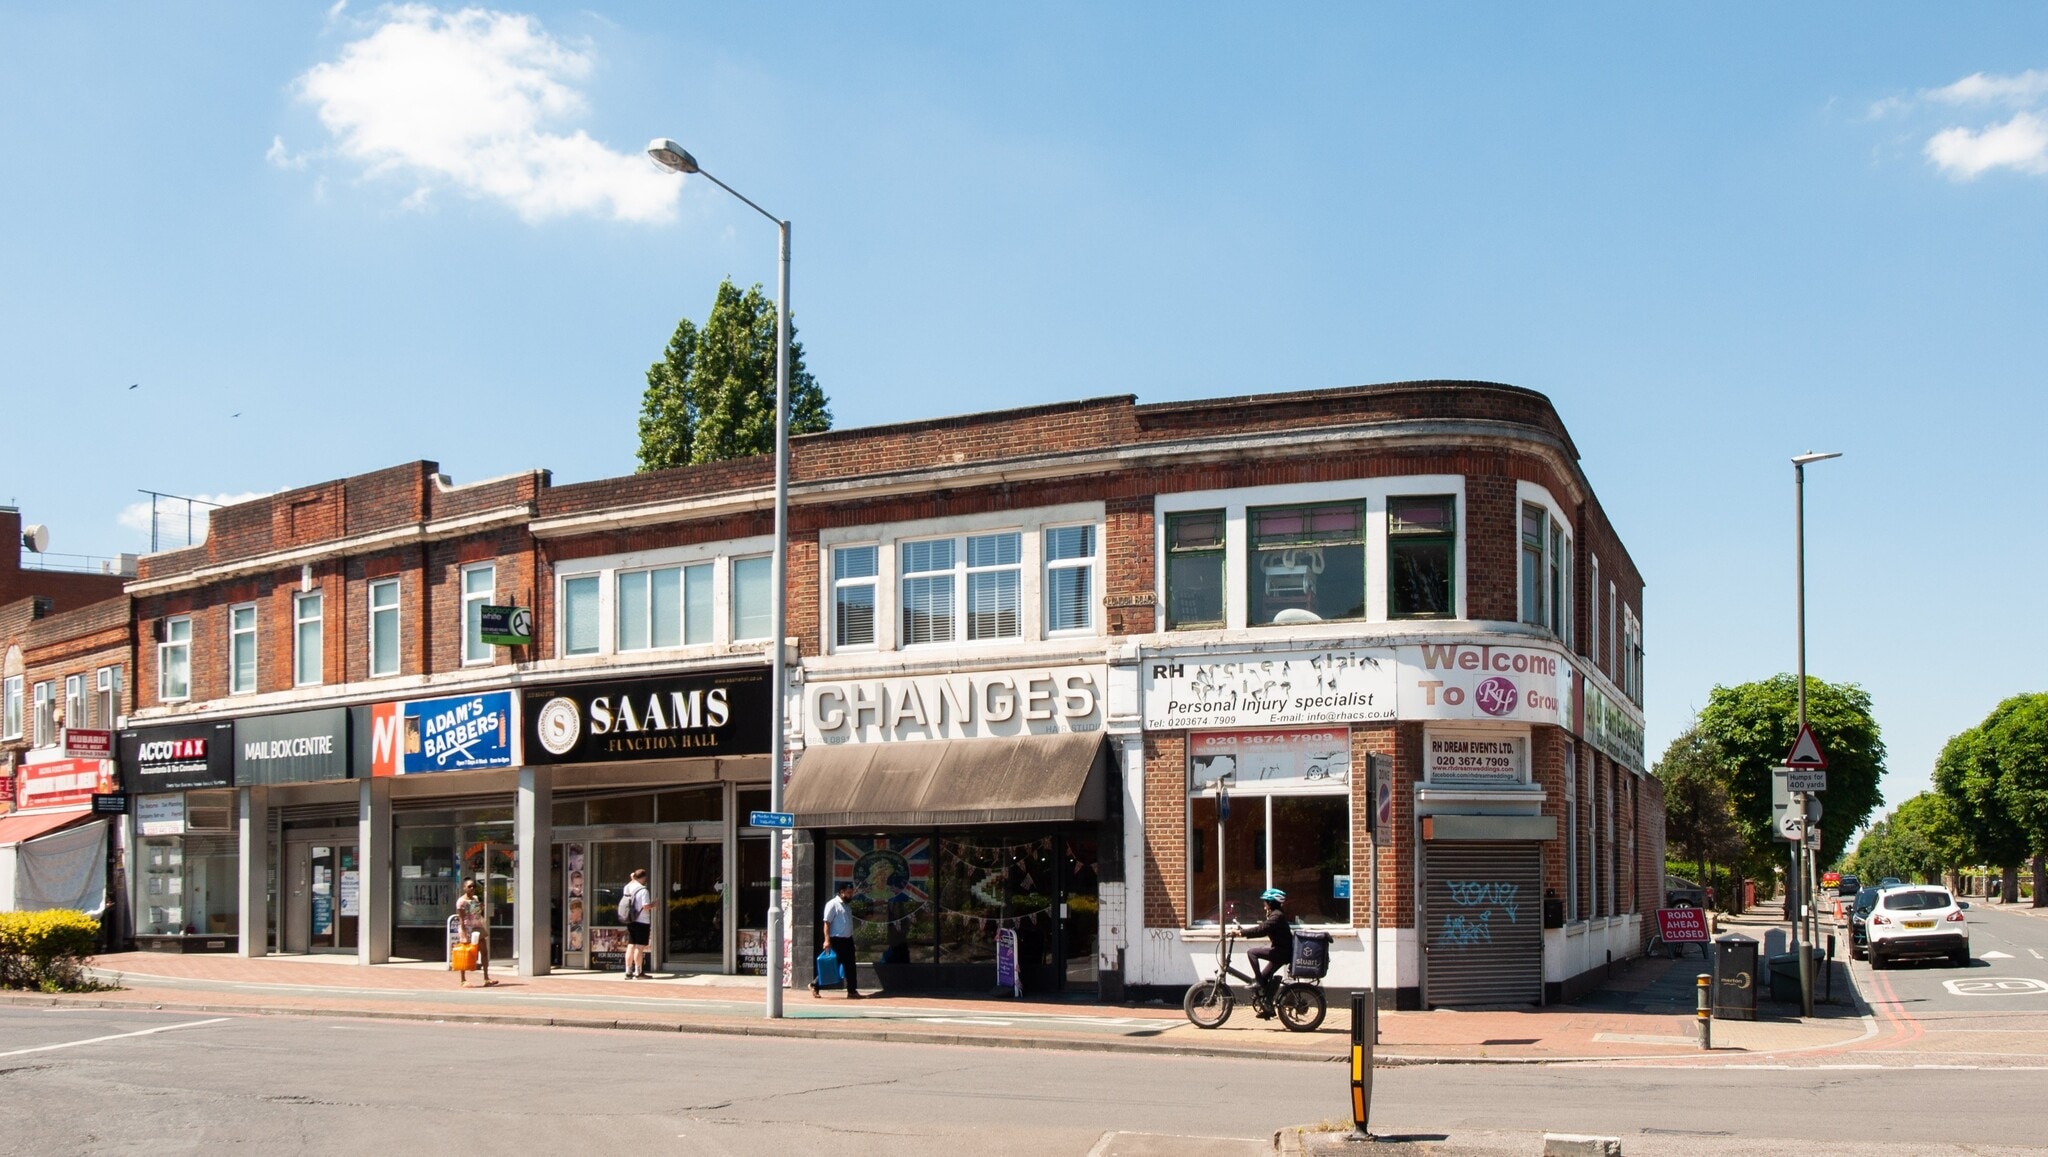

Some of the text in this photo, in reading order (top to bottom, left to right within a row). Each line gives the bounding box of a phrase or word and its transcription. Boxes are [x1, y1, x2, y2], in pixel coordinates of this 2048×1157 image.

[1421, 644, 1556, 676] Welcome
[1153, 664, 1185, 679] RH
[812, 669, 1095, 730] CHANGES
[1418, 681, 1465, 706] To
[1167, 692, 1374, 714] Personal Injury specialist
[426, 698, 483, 738] ADAM'S
[591, 688, 730, 734] SAAMS
[1269, 709, 1396, 723] E-mail: info@rhacs.co.uk
[553, 714, 565, 737] S
[1045, 722, 1104, 733] HAIR STUDIO
[1148, 718, 1166, 728] Tel:
[1213, 715, 1237, 725] 7909
[424, 712, 499, 757] BARBERS
[1205, 733, 1333, 745] 020 3674 7909
[245, 735, 333, 761] MAIL BOX CENTRE
[609, 733, 718, 751] FUNCTION HALL
[1432, 741, 1514, 754] RH DREAM EVENTS LTD.
[1436, 756, 1509, 766] 020 3674 7909
[1807, 781, 1825, 789] yards
[1667, 911, 1694, 919] ROAD
[1667, 920, 1699, 929] AHEAD
[1666, 930, 1704, 939] CLOSED
[1296, 957, 1317, 966] stuart
[1956, 982, 2038, 990] 20
